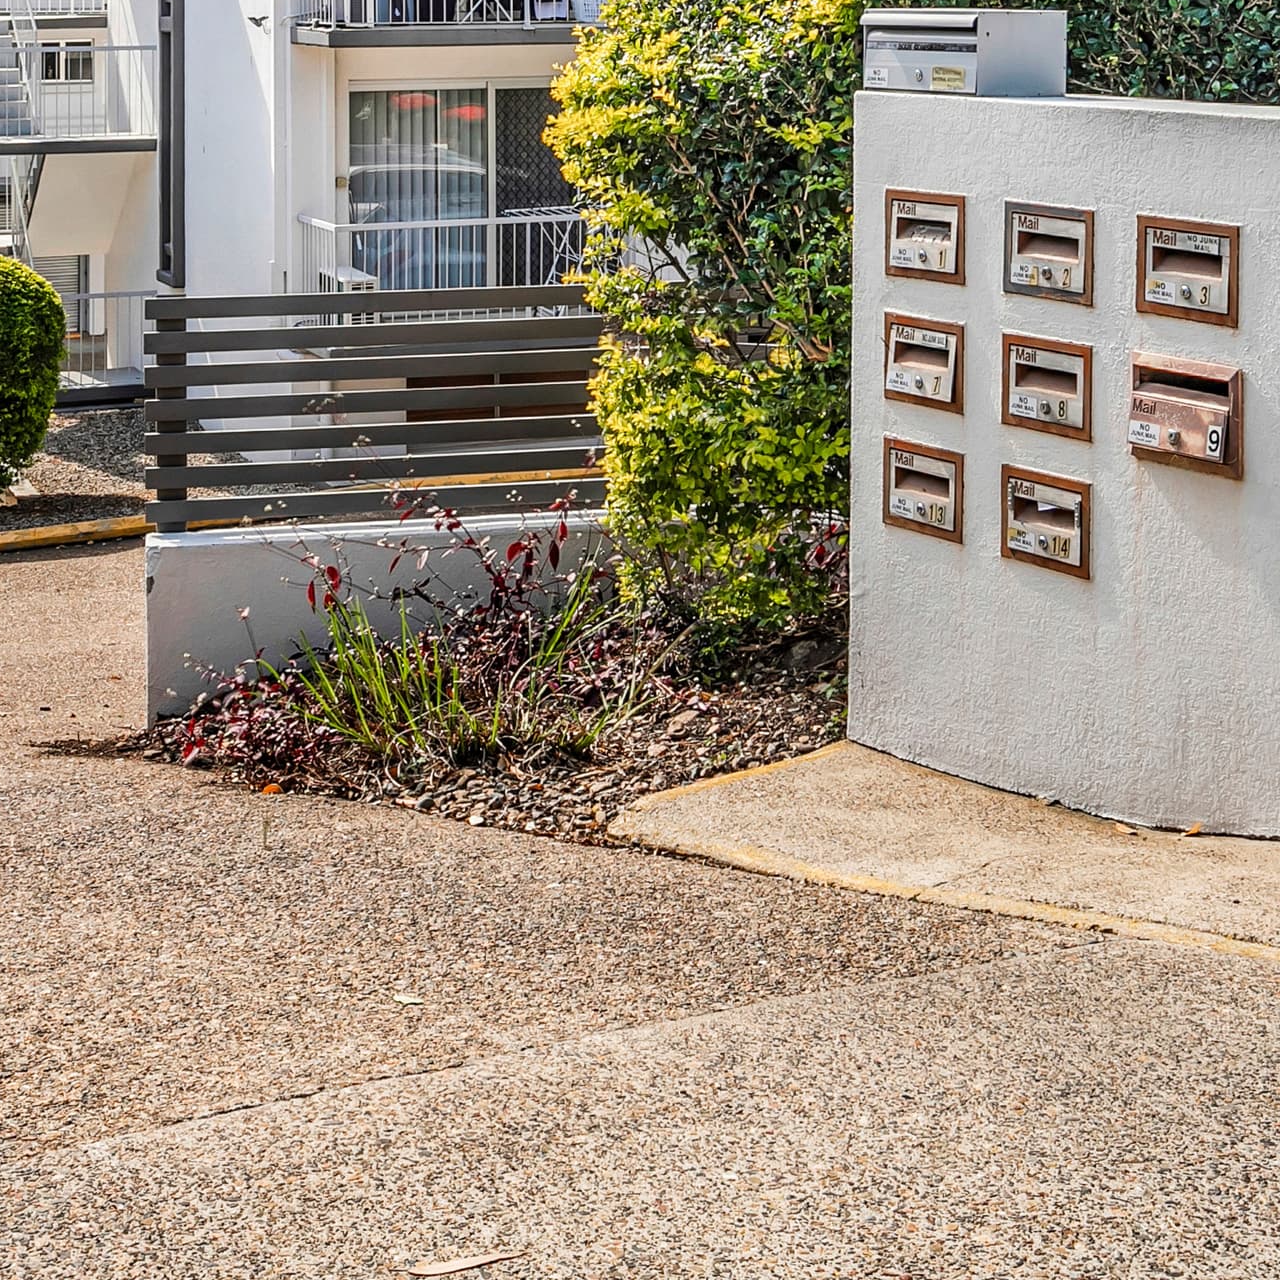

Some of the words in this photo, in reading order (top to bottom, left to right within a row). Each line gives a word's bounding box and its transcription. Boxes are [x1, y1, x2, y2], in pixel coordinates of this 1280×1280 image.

[896, 202, 917, 216] Mail
[1017, 215, 1039, 230] Mail
[1152, 230, 1177, 246] Mail
[939, 250, 943, 266] 1
[1062, 268, 1069, 286] 2
[1200, 286, 1208, 304] 3
[896, 326, 915, 341] Mail
[1016, 348, 1037, 363] Mail
[933, 376, 939, 393] 7
[1058, 401, 1065, 417] 8
[1132, 398, 1156, 415] Mail
[1130, 429, 1144, 437] JUNK
[1144, 432, 1157, 441] MAIL
[1139, 423, 1151, 432] NO
[1208, 429, 1220, 452] 9
[895, 452, 914, 468] Mail
[1015, 480, 1035, 497] Mail
[929, 504, 944, 523] 13
[1052, 536, 1067, 556] 14
